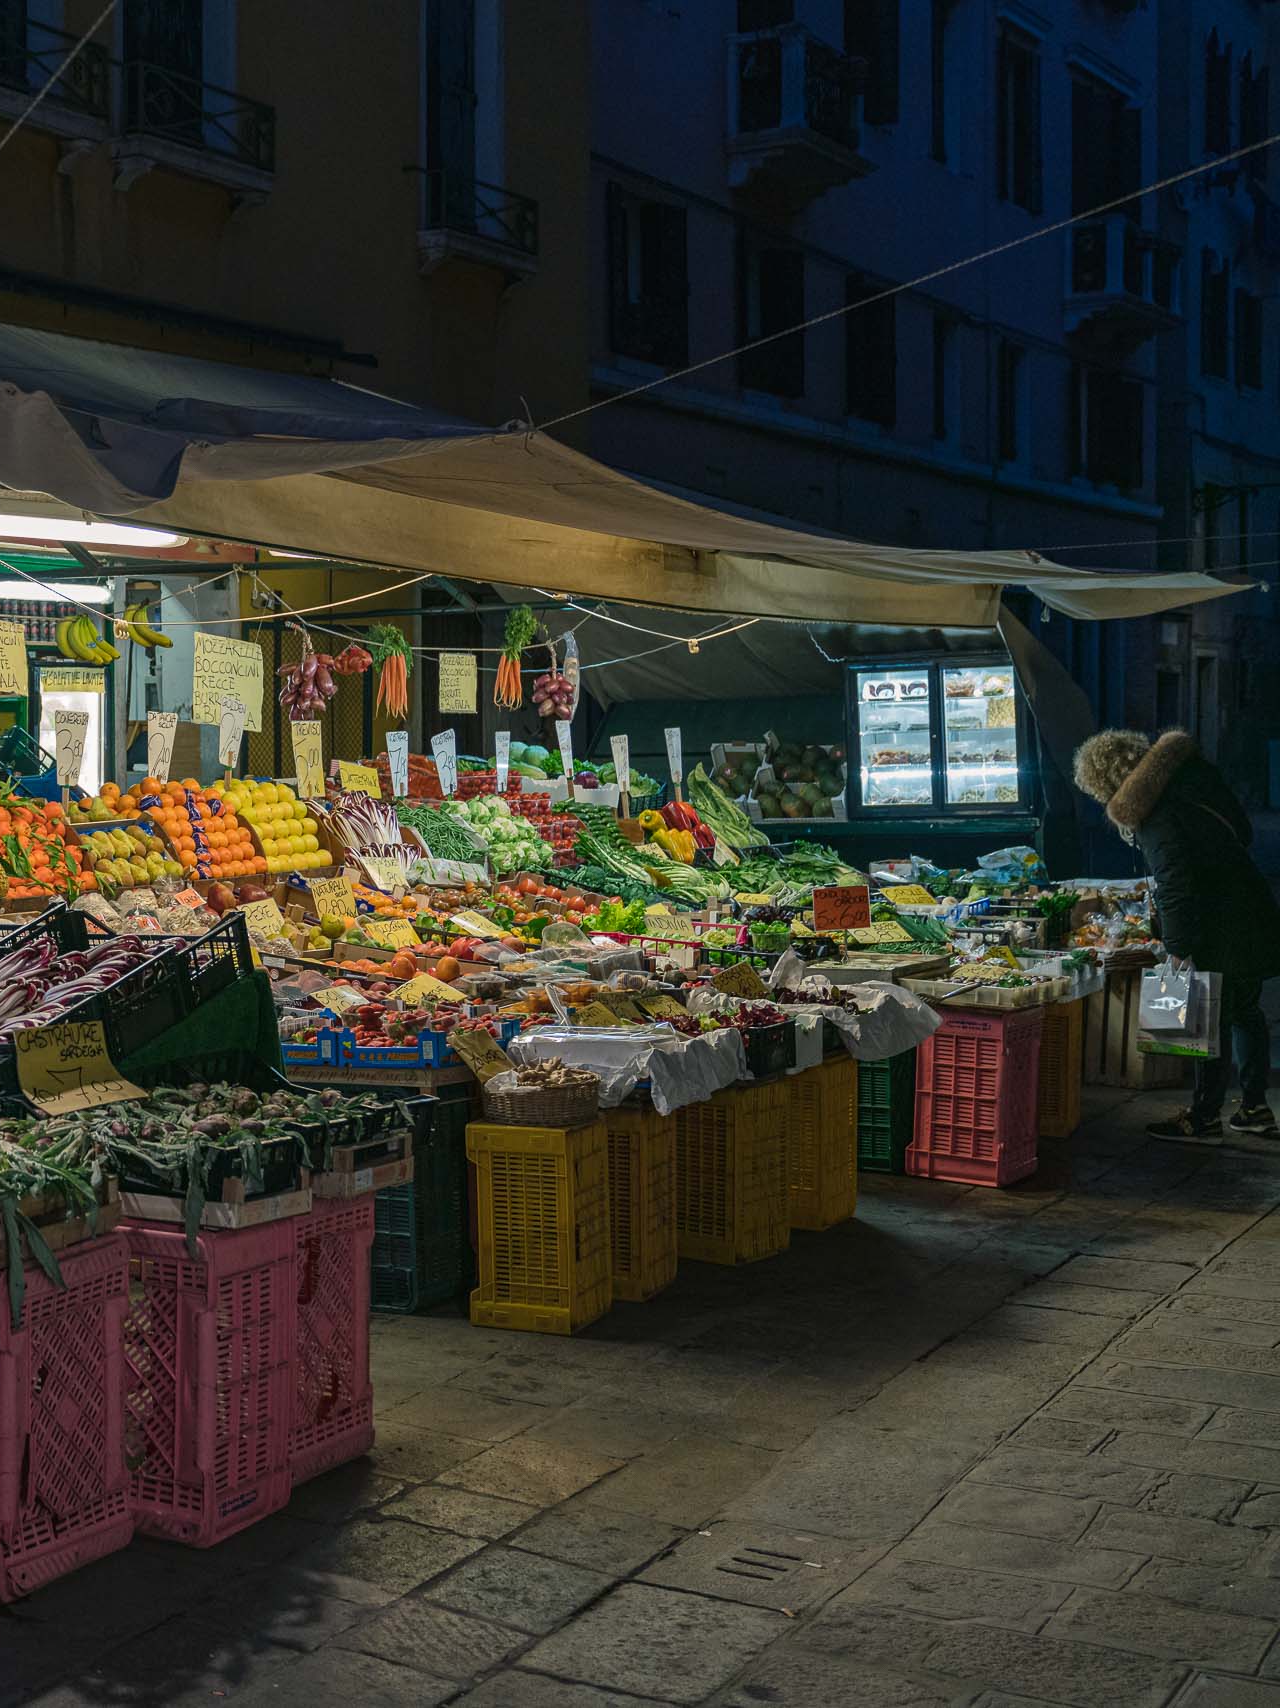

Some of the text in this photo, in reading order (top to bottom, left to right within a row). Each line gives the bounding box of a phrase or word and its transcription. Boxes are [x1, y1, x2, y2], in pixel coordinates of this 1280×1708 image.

[195, 656, 260, 678] BOCCONCINI
[193, 675, 235, 690] TRECCE
[194, 691, 241, 706] BURRTE
